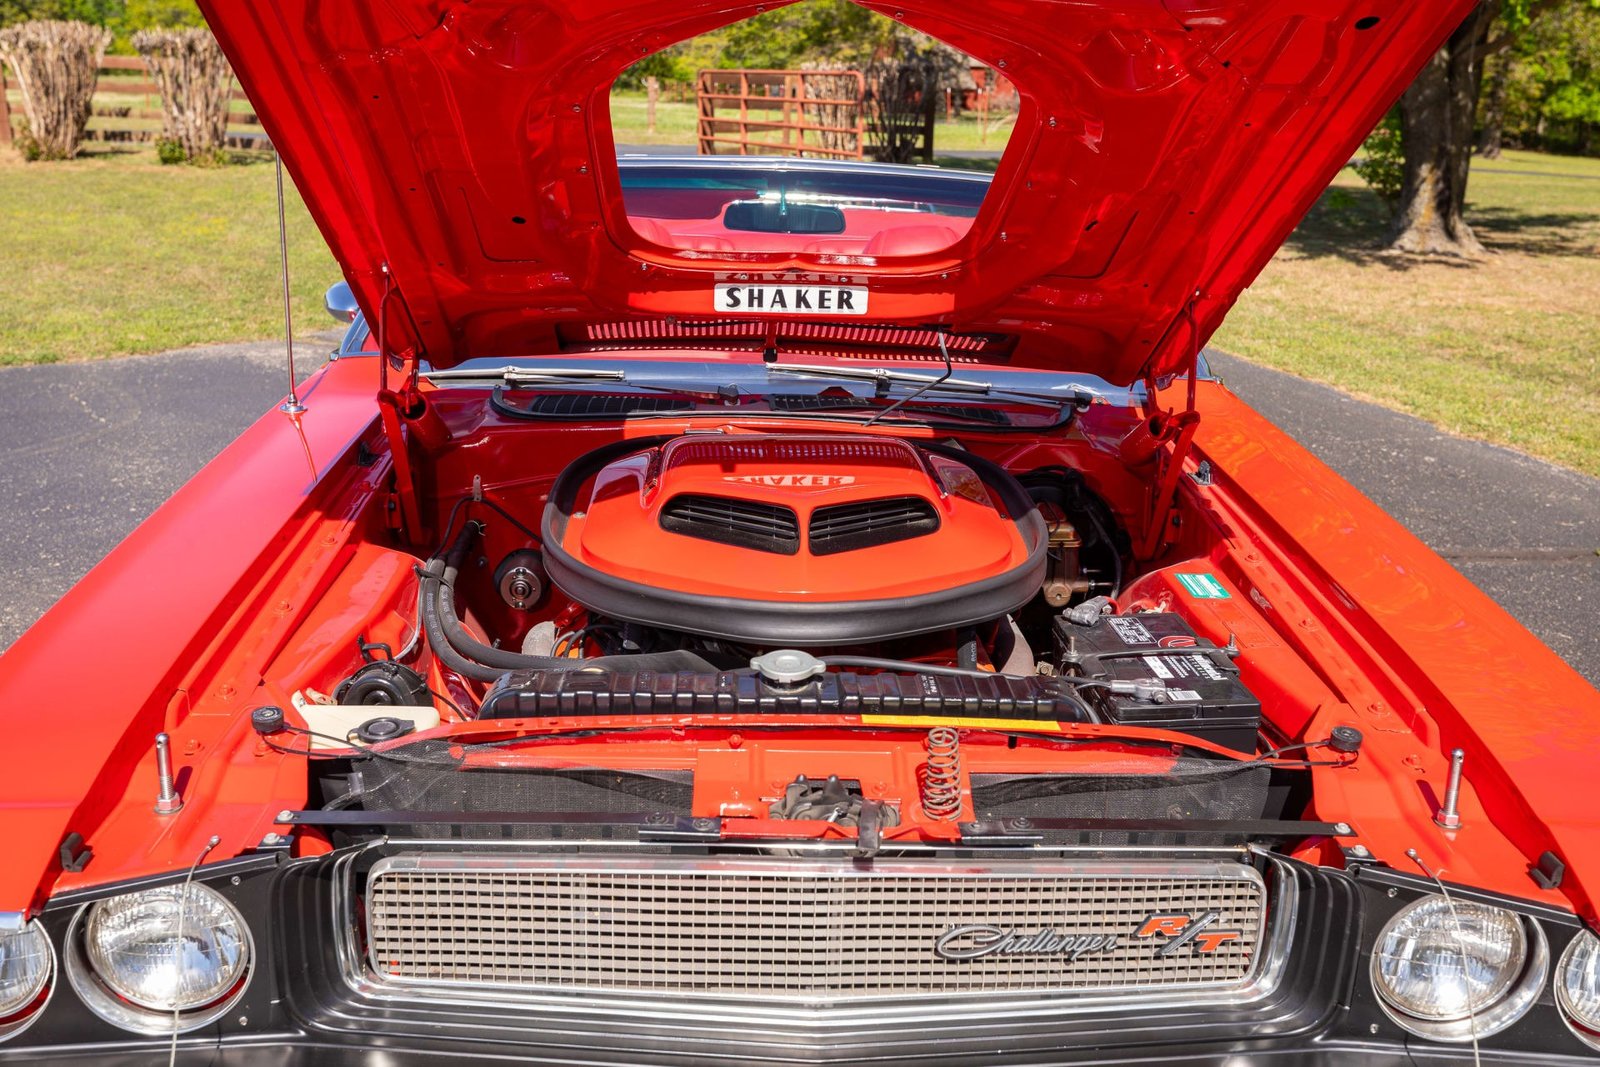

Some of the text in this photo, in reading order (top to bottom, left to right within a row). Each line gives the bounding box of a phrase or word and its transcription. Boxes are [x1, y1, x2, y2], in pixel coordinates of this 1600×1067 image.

[726, 287, 854, 310] SHAKER
[936, 911, 1243, 962] Challenger R/T
